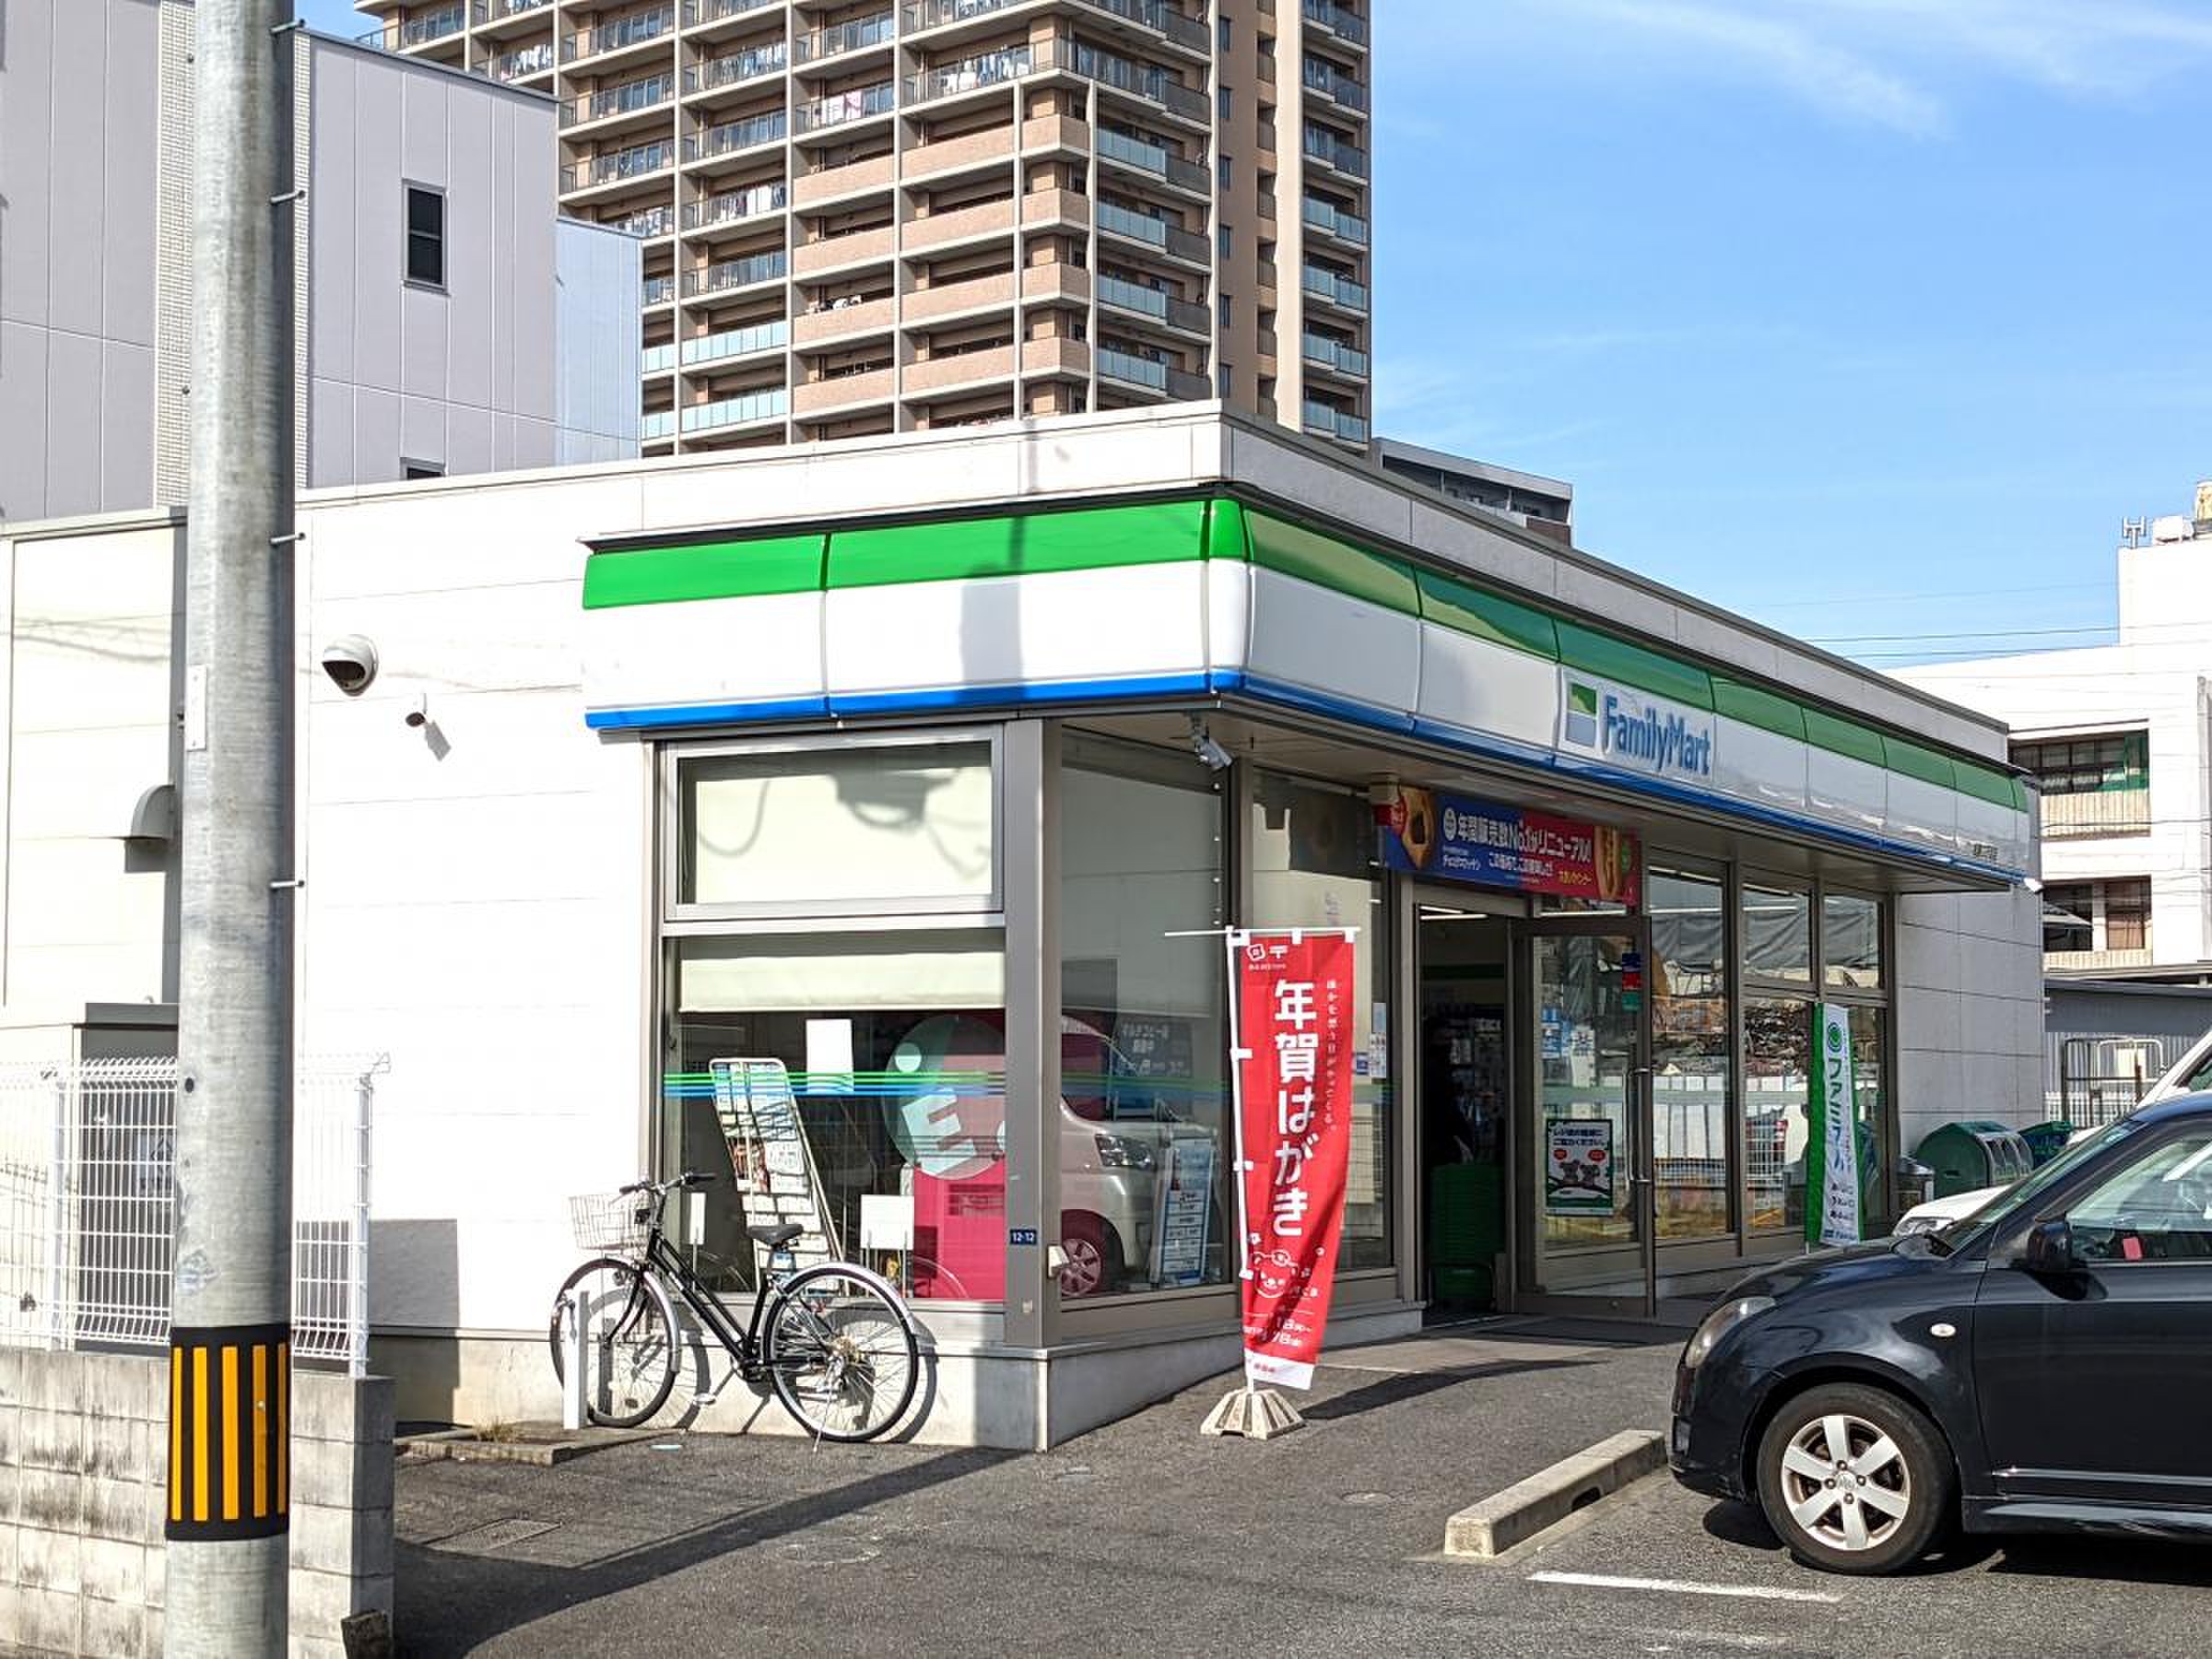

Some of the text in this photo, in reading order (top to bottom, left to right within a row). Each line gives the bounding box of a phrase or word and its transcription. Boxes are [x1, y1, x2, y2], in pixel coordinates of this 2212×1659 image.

[1605, 694, 1712, 775] FamilyMart
[1273, 979, 1319, 1237] 年賀はがき
